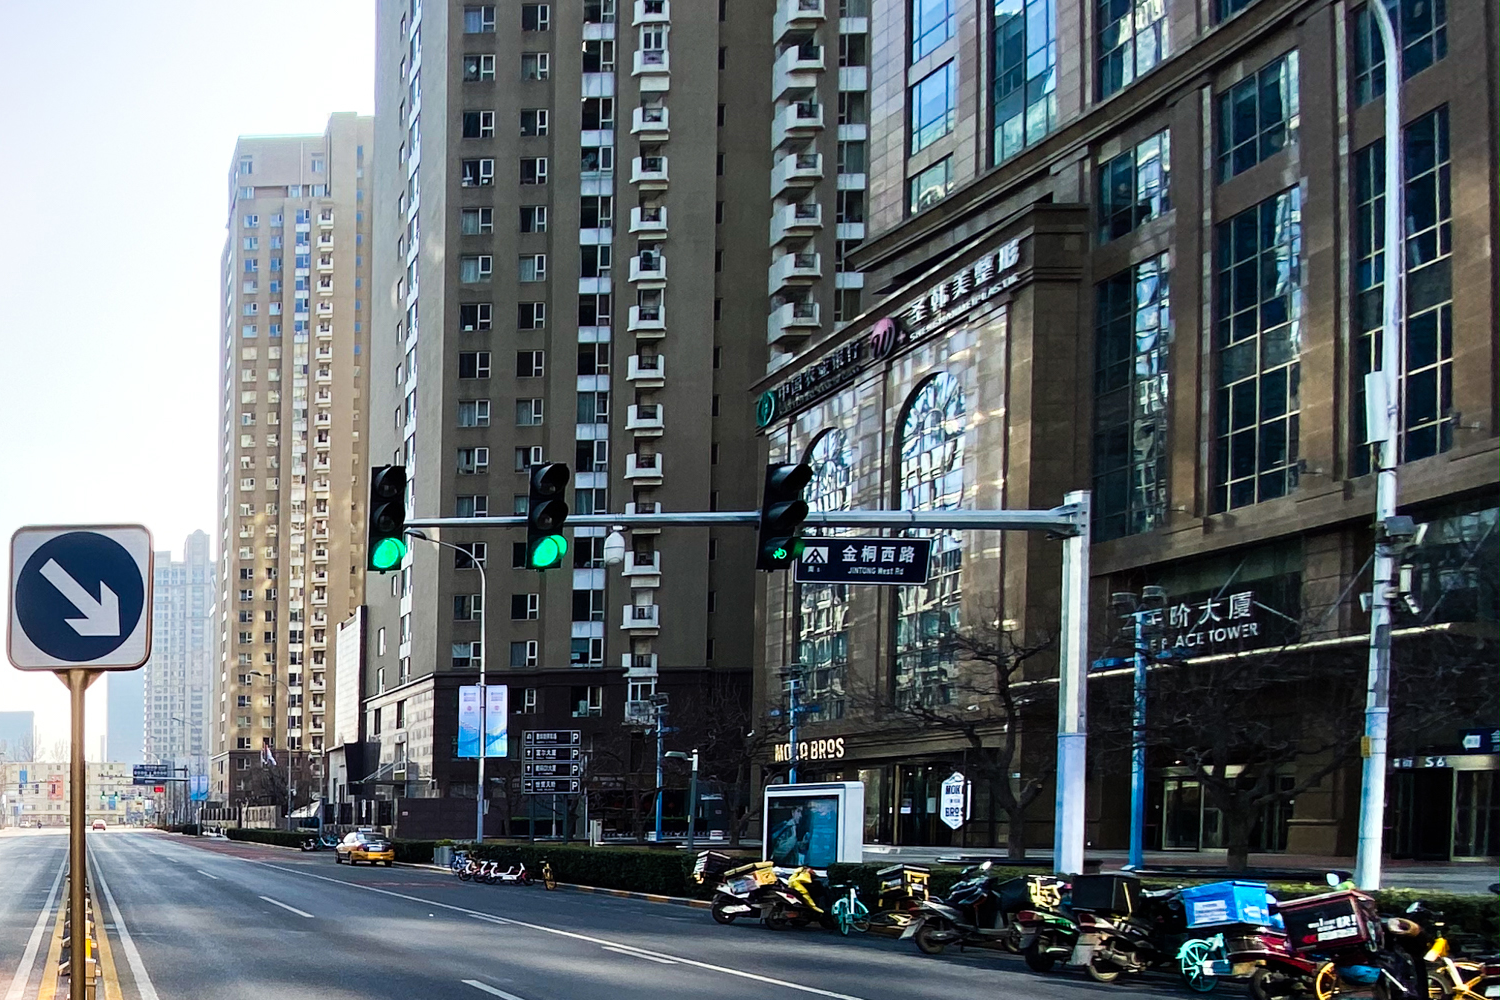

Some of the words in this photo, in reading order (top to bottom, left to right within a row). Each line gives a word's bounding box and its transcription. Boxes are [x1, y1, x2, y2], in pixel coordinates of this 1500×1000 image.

[842, 544, 915, 563] 金桐西路
[848, 566, 876, 575] JINTONG
[877, 567, 894, 575] West
[1161, 632, 1205, 650] PACE
[1209, 622, 1259, 642] TOWER
[572, 733, 579, 743] P
[810, 737, 845, 760] BROS
[572, 749, 578, 759] P
[572, 765, 578, 775] P
[571, 781, 578, 790] P
